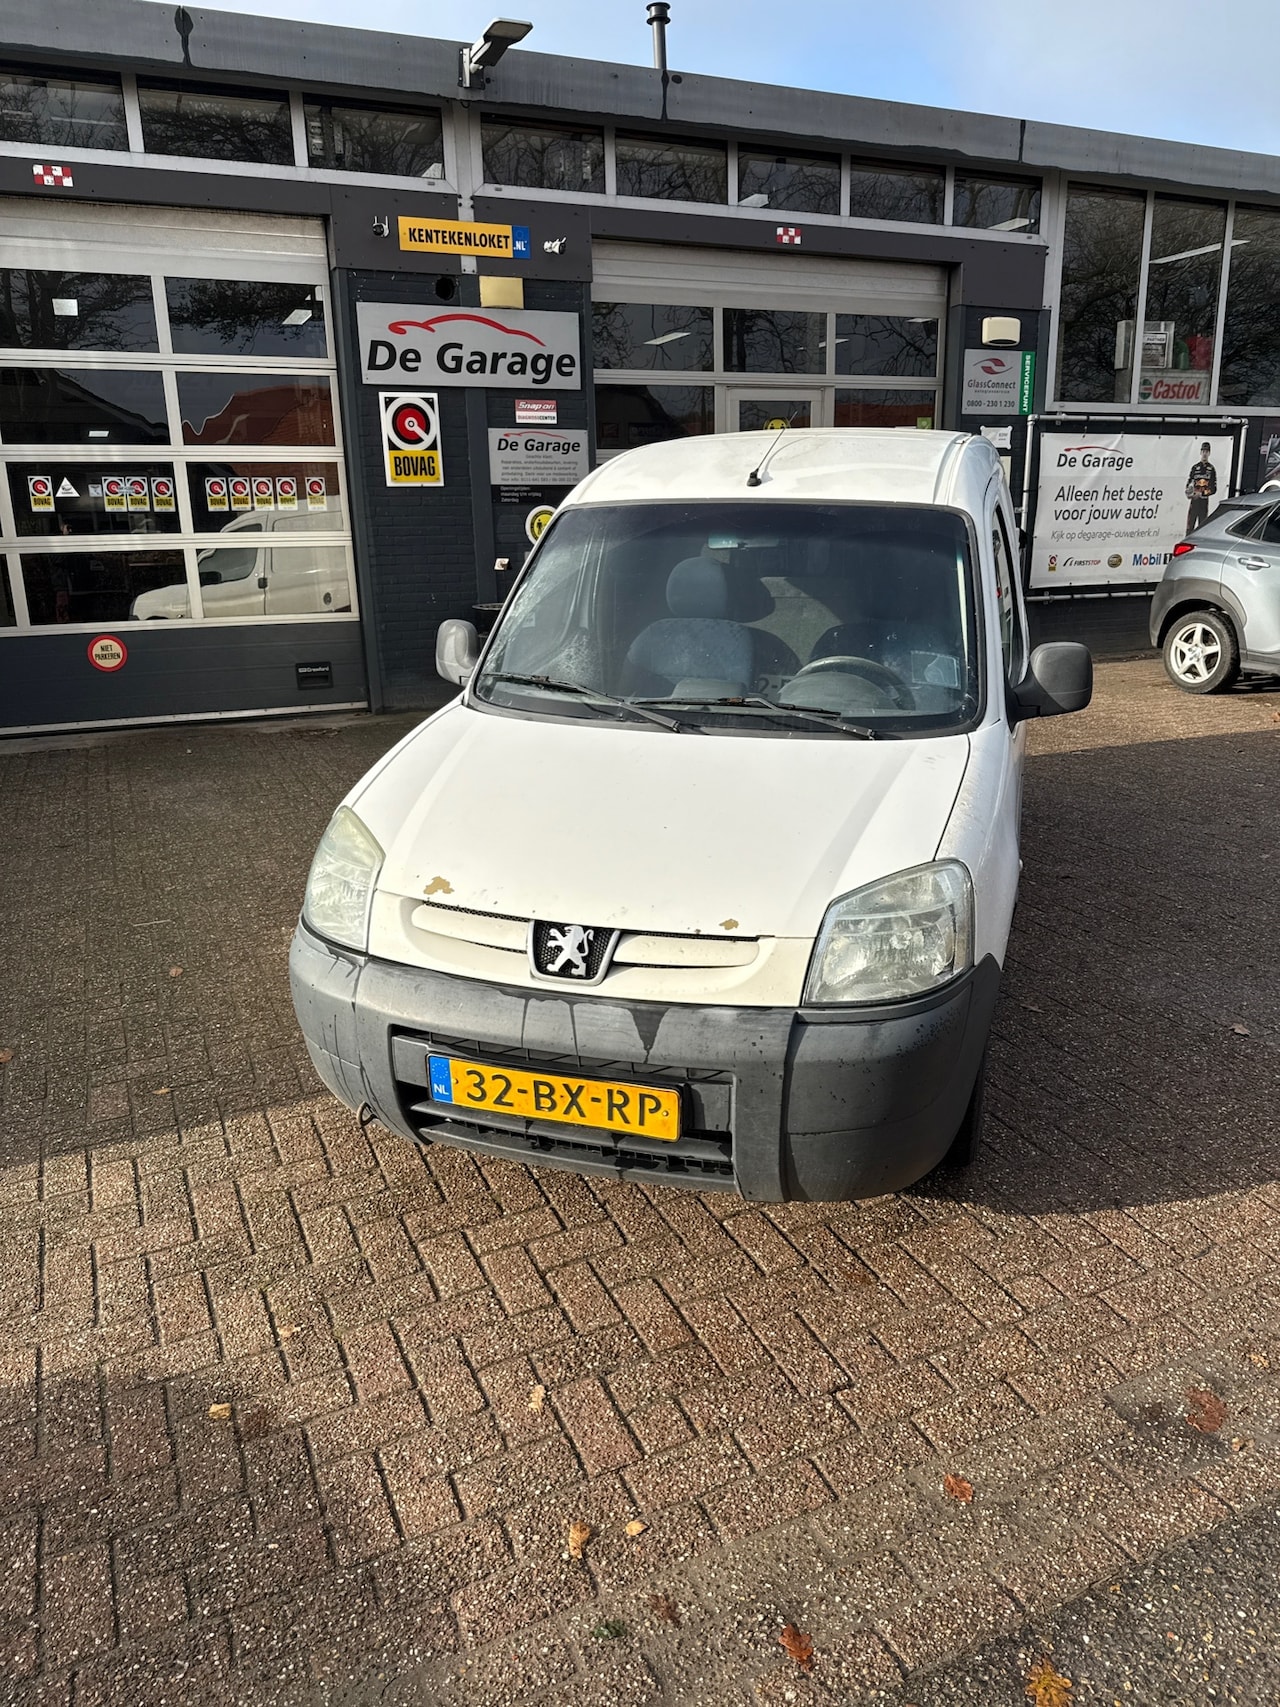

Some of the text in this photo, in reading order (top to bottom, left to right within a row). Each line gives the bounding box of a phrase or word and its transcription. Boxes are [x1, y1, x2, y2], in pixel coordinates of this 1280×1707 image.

[408, 227, 510, 250] KENTEKENLOKET
[367, 340, 576, 385] De Garage
[967, 379, 1016, 389] GlassConnect
[1023, 354, 1031, 413] SERVICEPUNT
[1152, 380, 1201, 400] Castrol
[986, 400, 998, 408] 230
[497, 438, 581, 455] De Garage
[394, 455, 436, 477] BOVAG
[1056, 453, 1134, 471] De Garage
[1054, 485, 1163, 502] Alleen het beste
[1054, 504, 1159, 525] voor jouw auto!
[1051, 528, 1160, 542] Kijk op degarage-ouwerkerk.nl
[1073, 559, 1102, 567] FIRSTSTOP
[1132, 553, 1162, 566] Mobil
[94, 652, 121, 661] PARKEREN
[100, 644, 113, 652] NIET
[433, 1069, 662, 1127] NL 32-BX-RP
